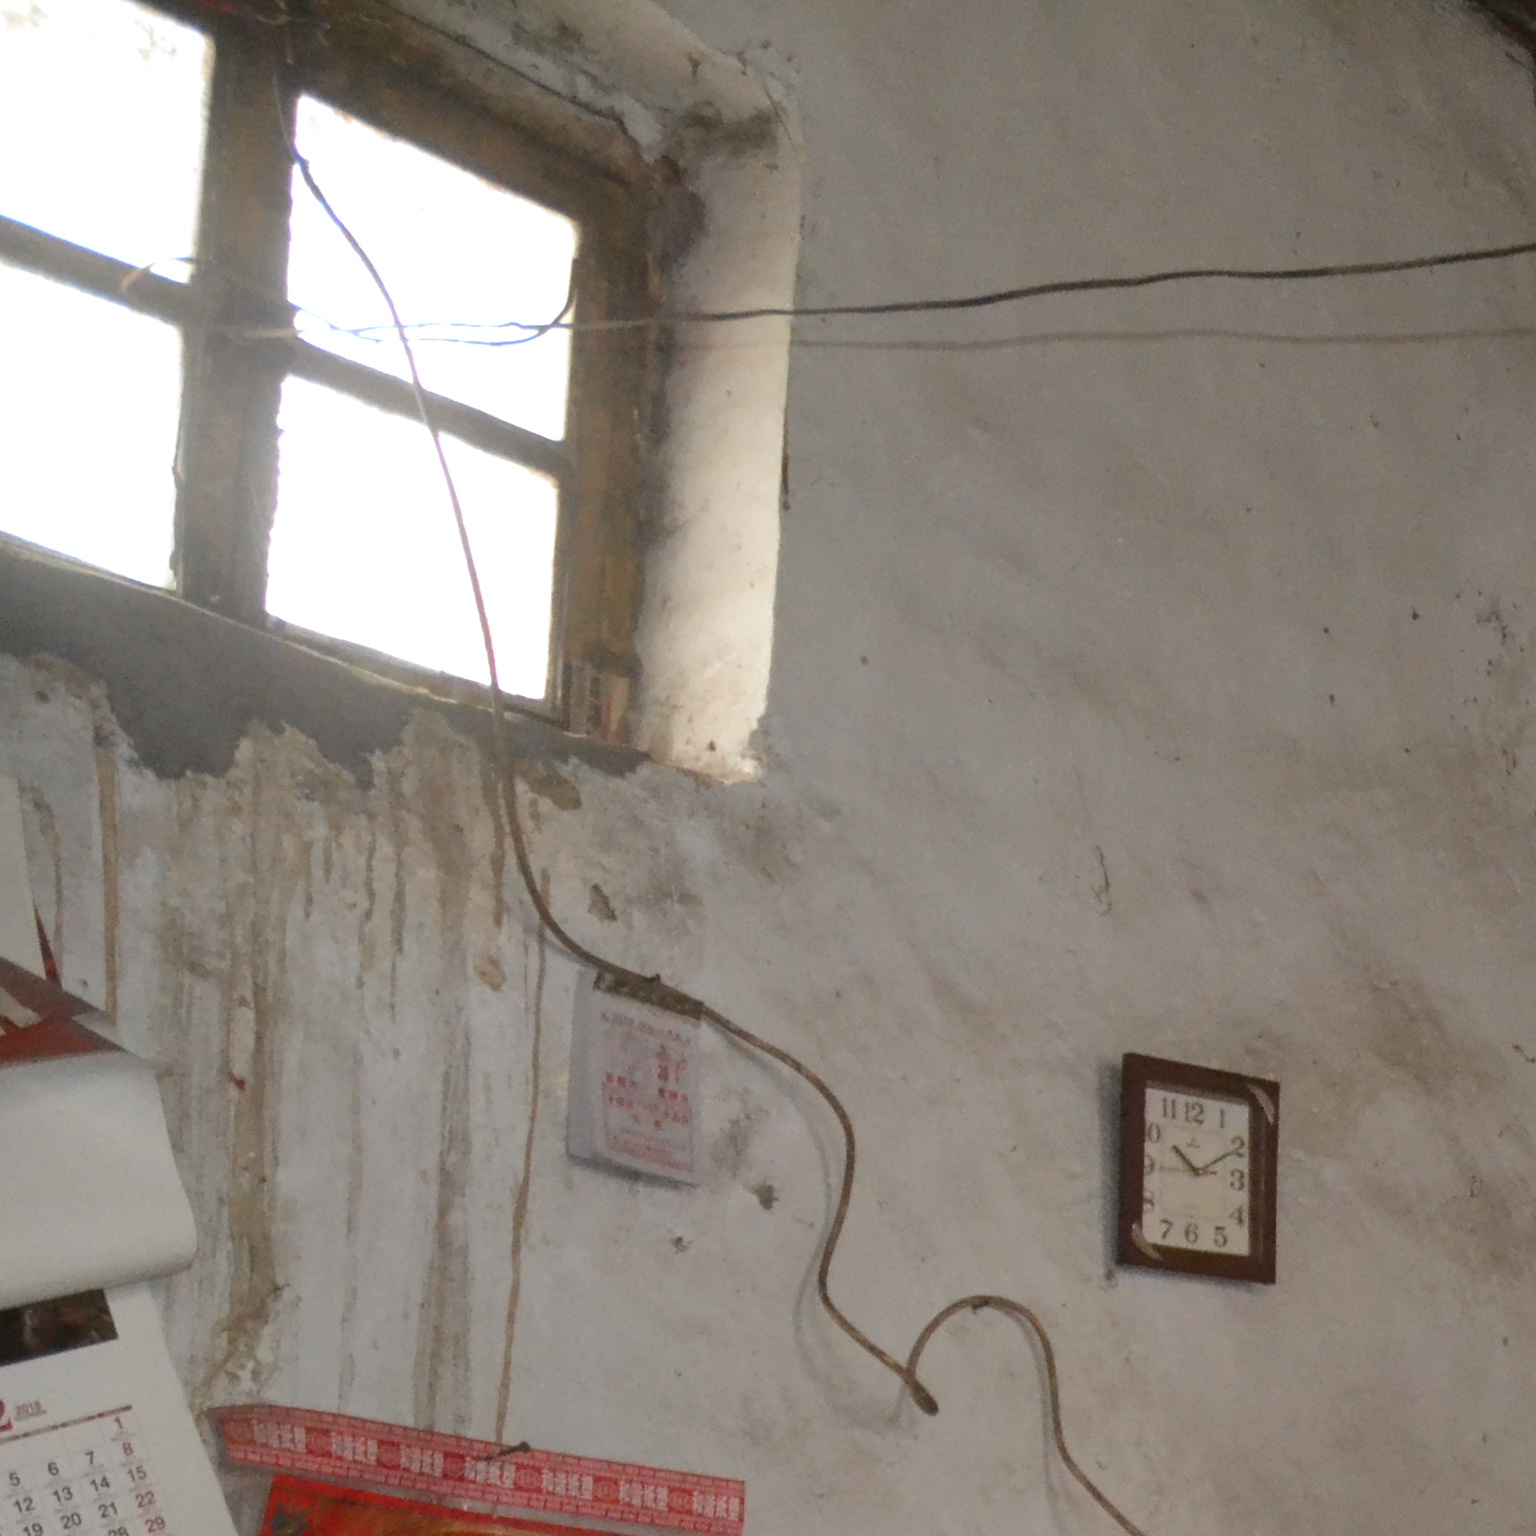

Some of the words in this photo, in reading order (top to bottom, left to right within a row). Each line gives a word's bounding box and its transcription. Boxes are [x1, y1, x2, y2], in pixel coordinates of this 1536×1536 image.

[1162, 1097, 1177, 1120] 11
[1184, 1101, 1205, 1125] 12
[1218, 1108, 1226, 1129] 1
[1230, 1135, 1246, 1158] 2
[1229, 1169, 1246, 1191] 3
[1228, 1205, 1244, 1226] 4
[1160, 1219, 1174, 1240] 7
[1184, 1223, 1199, 1244] 6
[1213, 1226, 1228, 1248] 5
[114, 1416, 124, 1430] 1
[9, 1472, 21, 1487] 5
[48, 1462, 59, 1476] 6
[85, 1451, 95, 1465] 7
[122, 1442, 133, 1456] 8
[14, 1497, 36, 1513] 12
[53, 1486, 73, 1503] 13
[90, 1476, 110, 1493] 14
[127, 1465, 147, 1482] 15
[60, 1512, 82, 1530] 20
[98, 1502, 118, 1518] 21
[135, 1491, 156, 1508] 22
[145, 1516, 165, 1533] 29
